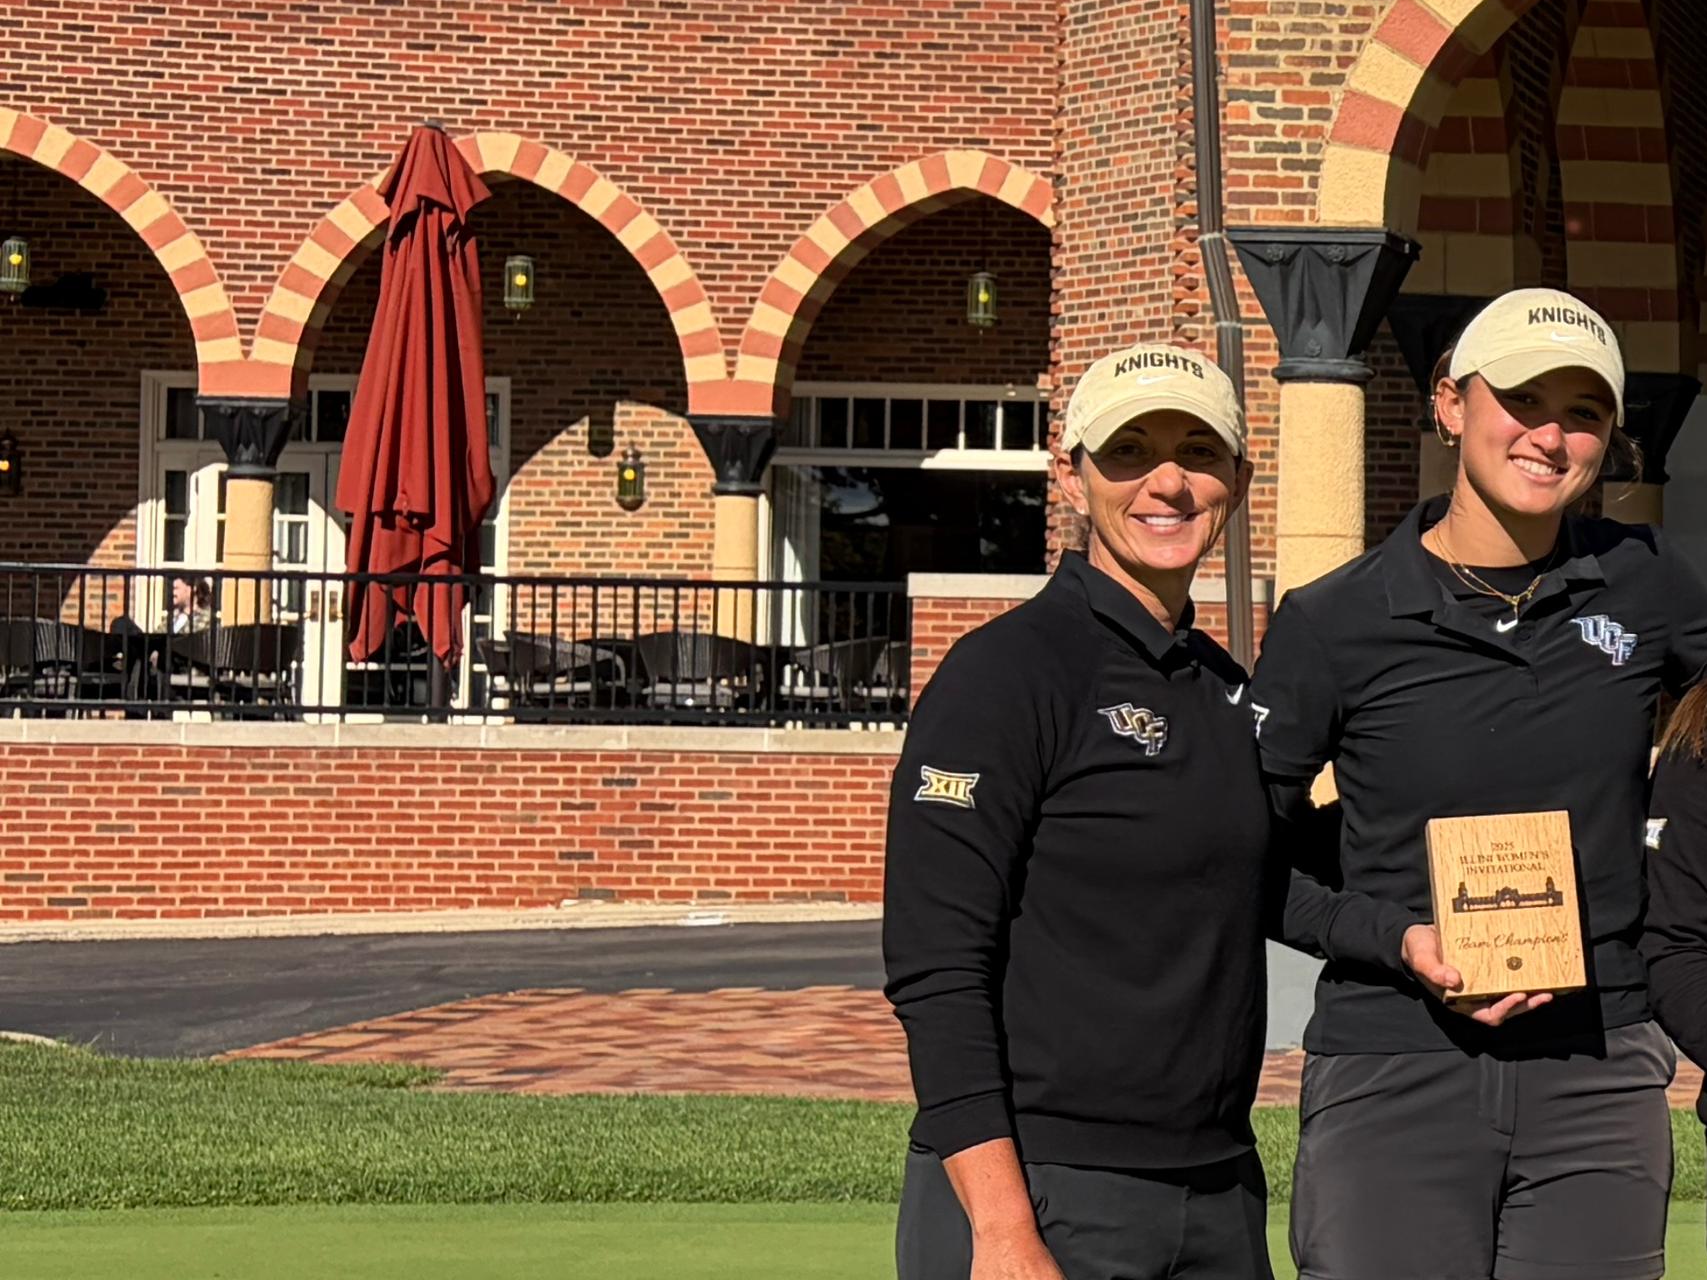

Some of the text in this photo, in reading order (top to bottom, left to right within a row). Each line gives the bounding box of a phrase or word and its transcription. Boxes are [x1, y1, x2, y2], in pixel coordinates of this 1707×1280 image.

[1528, 306, 1607, 346] KNIGHTS
[1114, 352, 1204, 380] KNIGHTS
[1568, 614, 1638, 666] UCF
[1097, 703, 1168, 756] UCF
[918, 769, 976, 805] XII
[1466, 862, 1546, 875] INVITATIONAL
